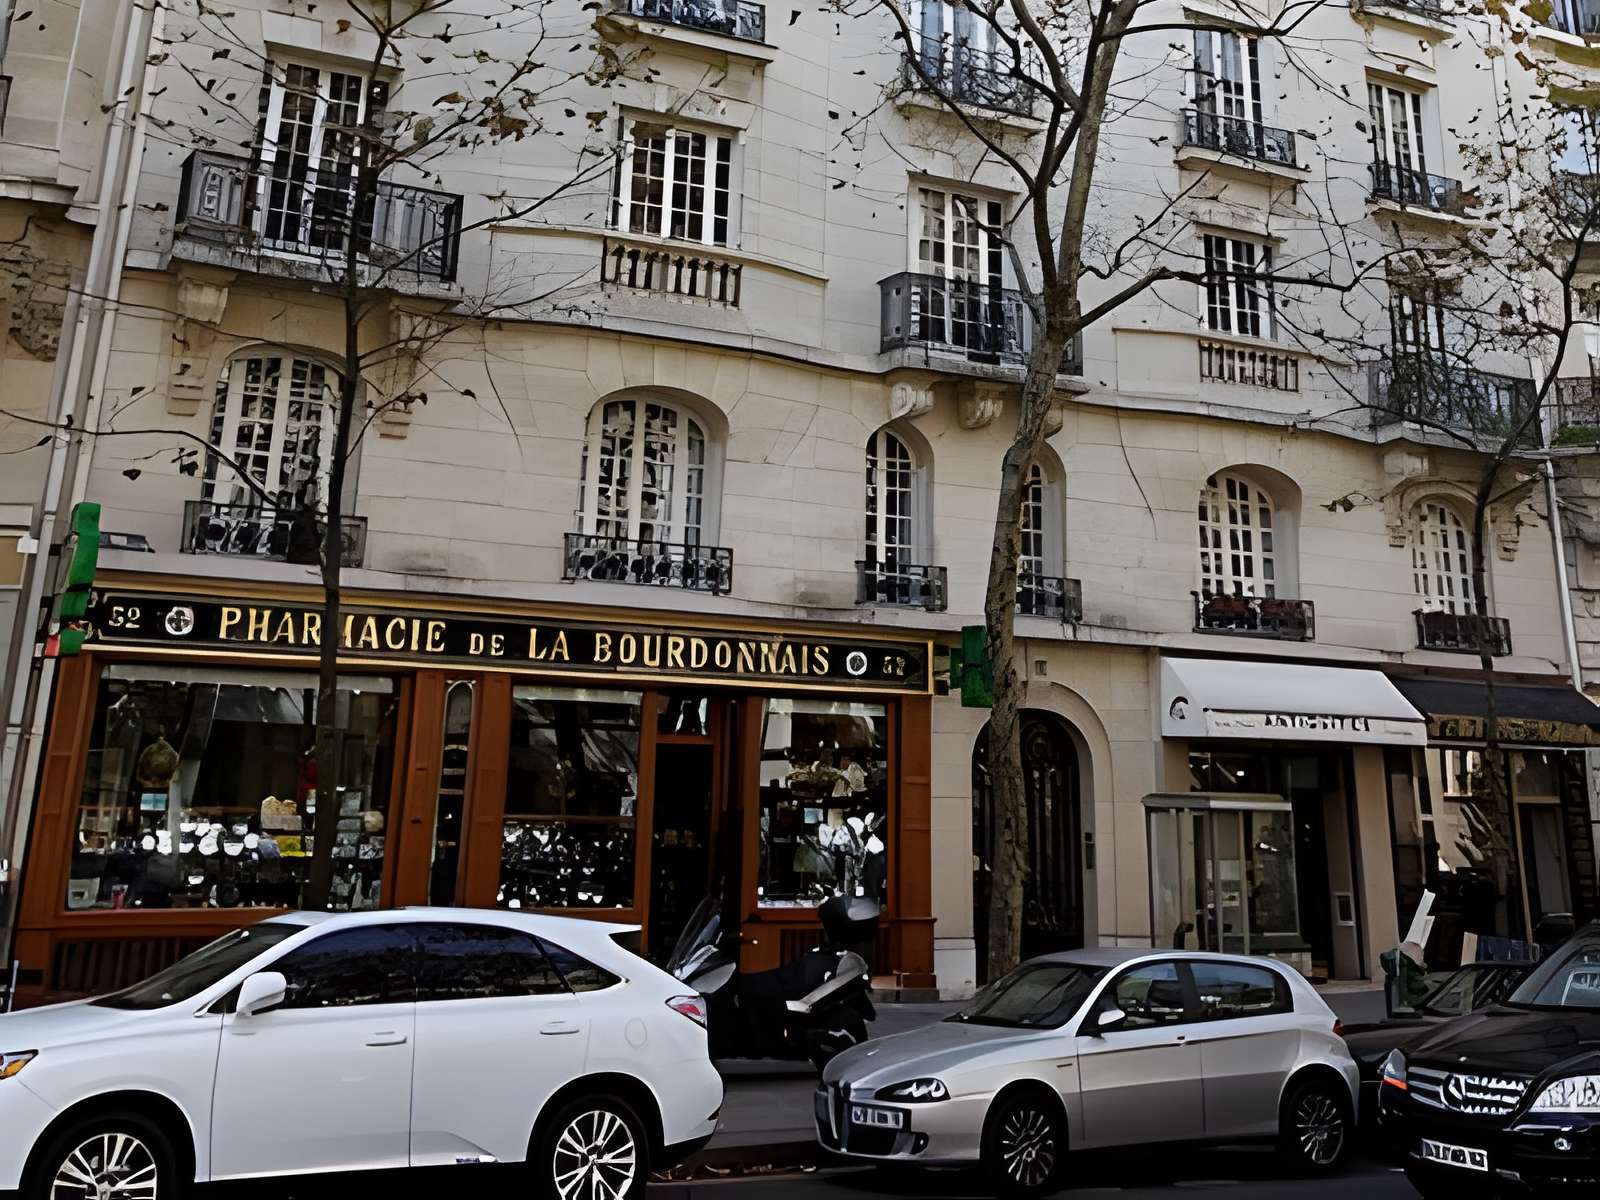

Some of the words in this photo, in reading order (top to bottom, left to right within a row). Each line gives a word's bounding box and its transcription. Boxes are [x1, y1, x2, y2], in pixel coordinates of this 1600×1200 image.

[469, 632, 505, 656] DE
[528, 627, 571, 661] LA
[593, 632, 829, 676] BOURDONNAIS
